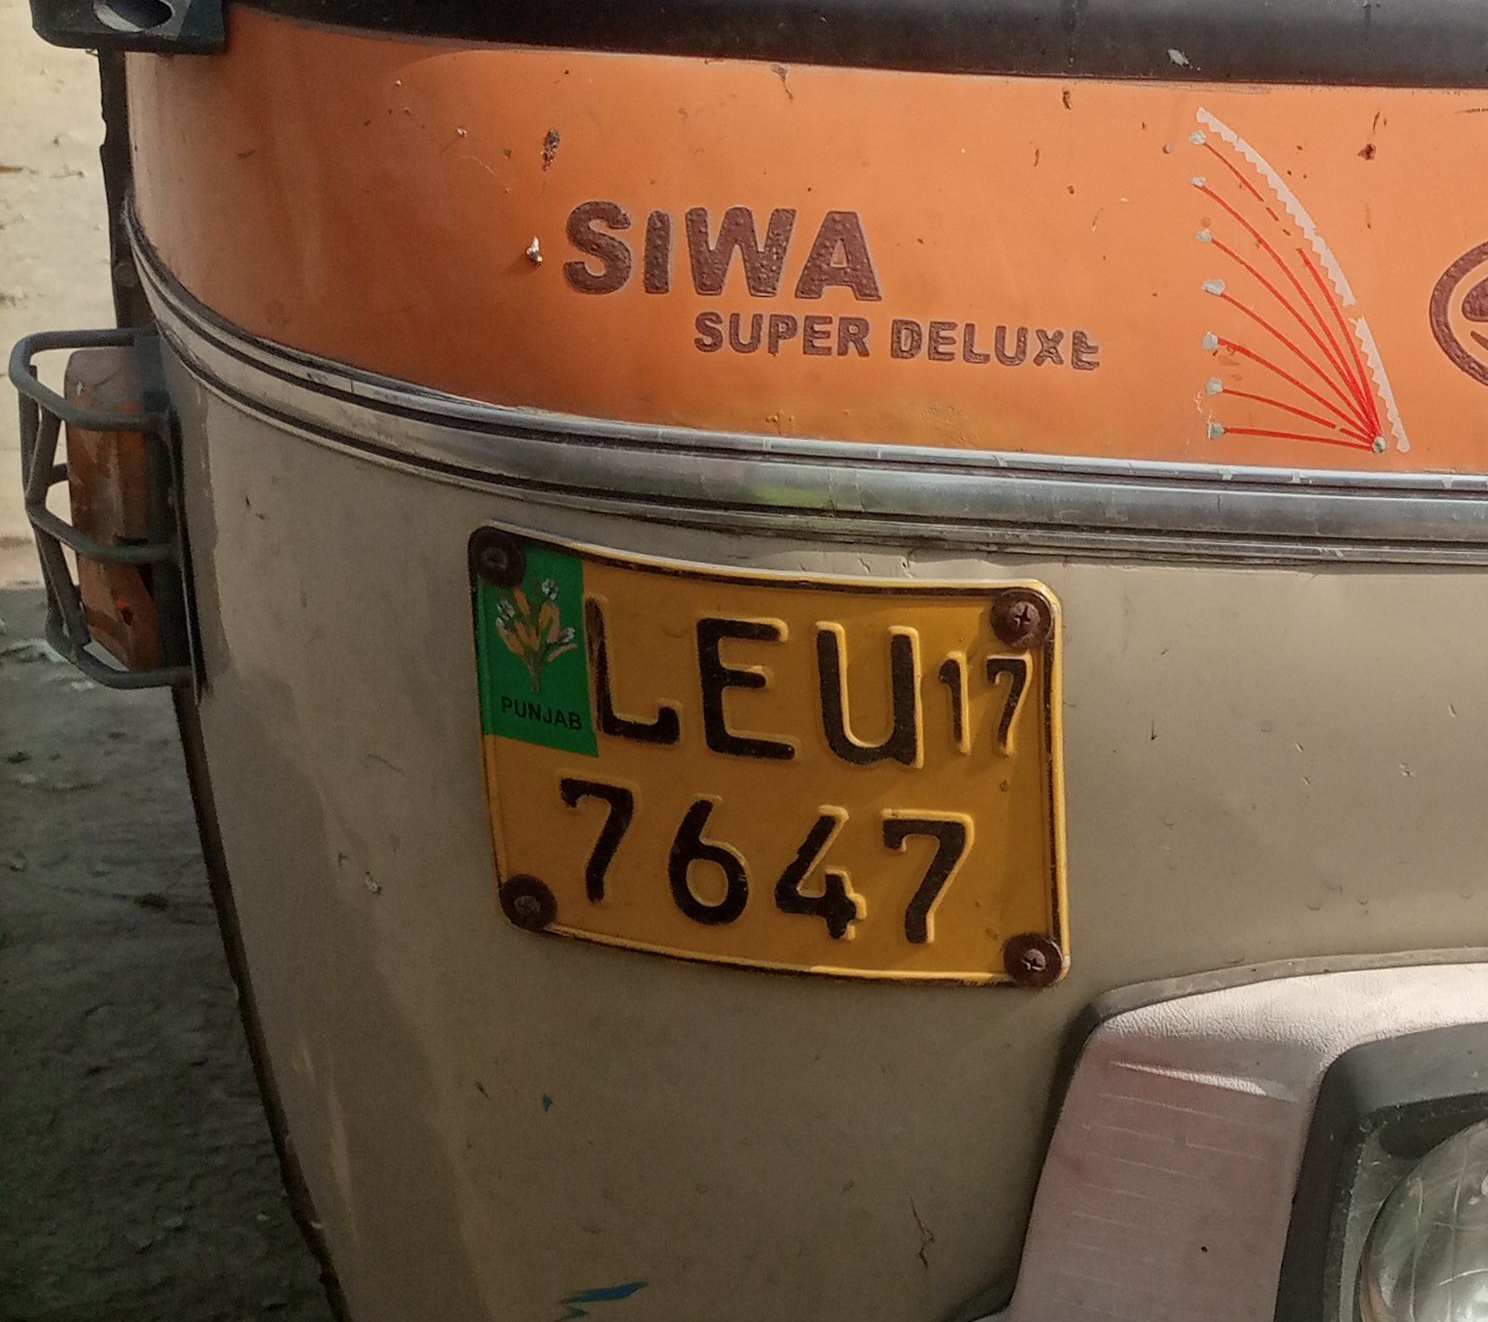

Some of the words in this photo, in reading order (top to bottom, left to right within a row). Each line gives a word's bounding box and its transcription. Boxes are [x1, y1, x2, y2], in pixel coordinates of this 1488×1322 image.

[563, 200, 882, 302] SIWA
[694, 310, 871, 359] SUPER
[890, 318, 1101, 371] DELUXE
[500, 696, 583, 732] PUNJAB
[583, 597, 924, 769] LEU
[937, 651, 1032, 756] 17
[560, 775, 974, 944] 7647
